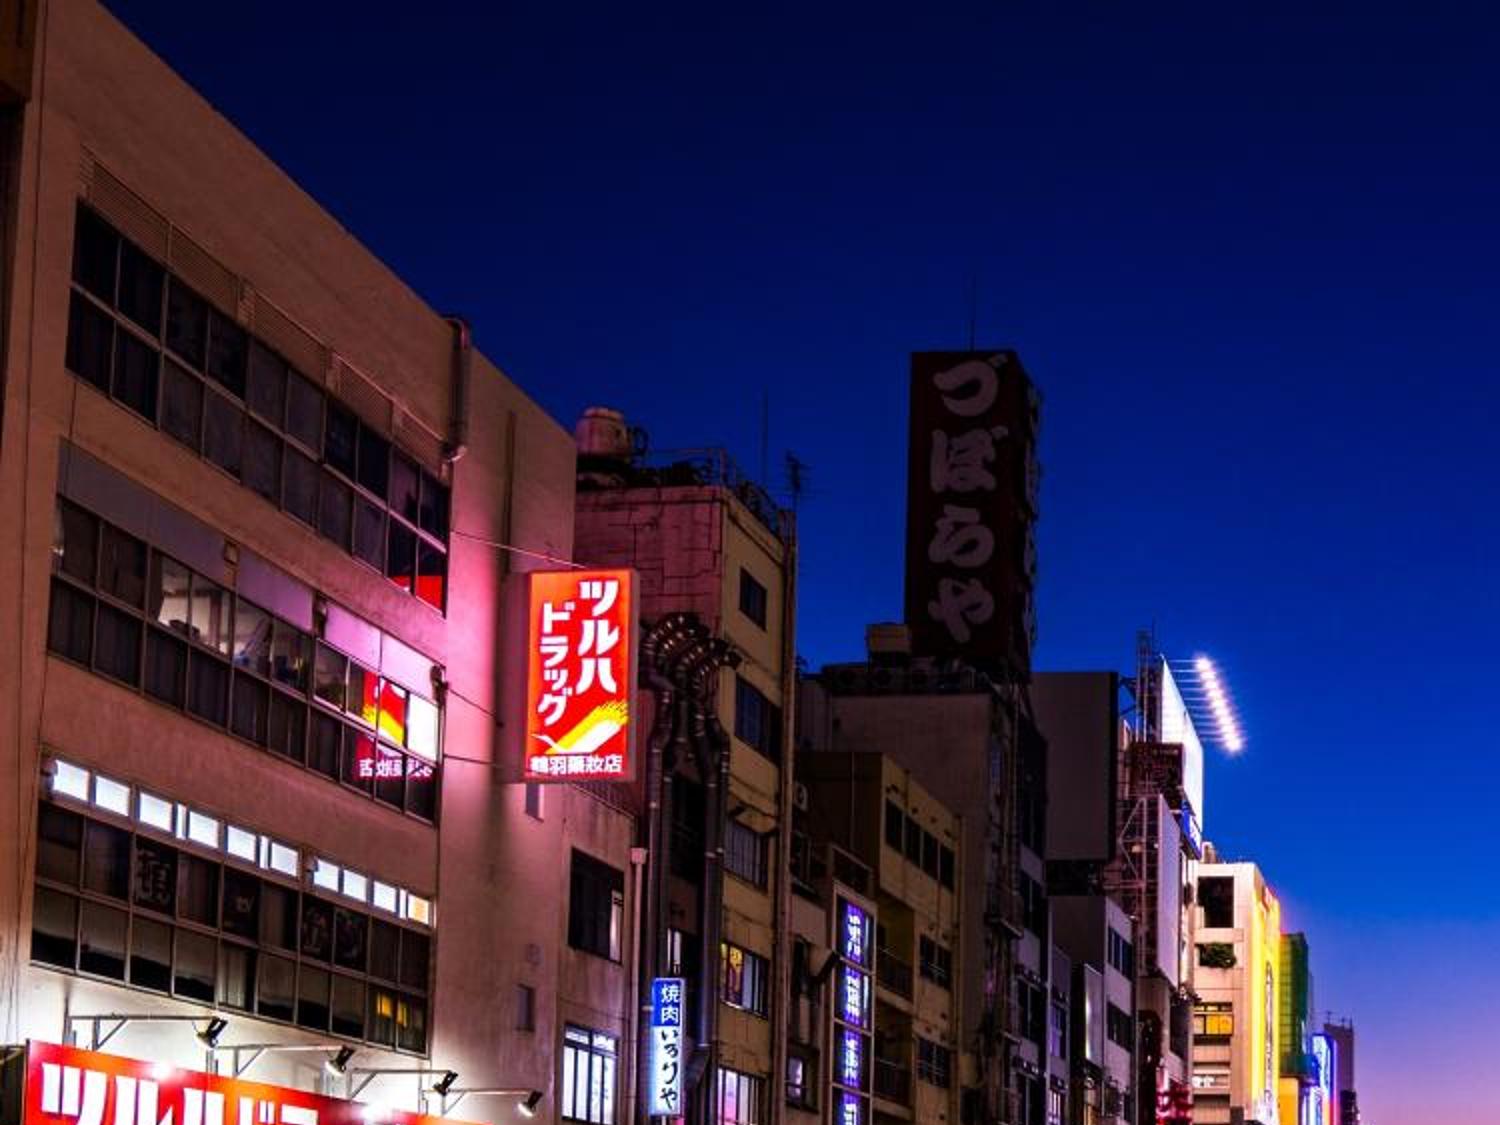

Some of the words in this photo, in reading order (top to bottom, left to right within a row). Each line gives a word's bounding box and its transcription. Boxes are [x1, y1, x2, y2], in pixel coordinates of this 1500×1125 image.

[538, 602, 576, 728] ドラッグ
[576, 580, 620, 695] ツルハ
[660, 984, 681, 1024] 焼肉
[660, 1029, 679, 1110] いろりや
